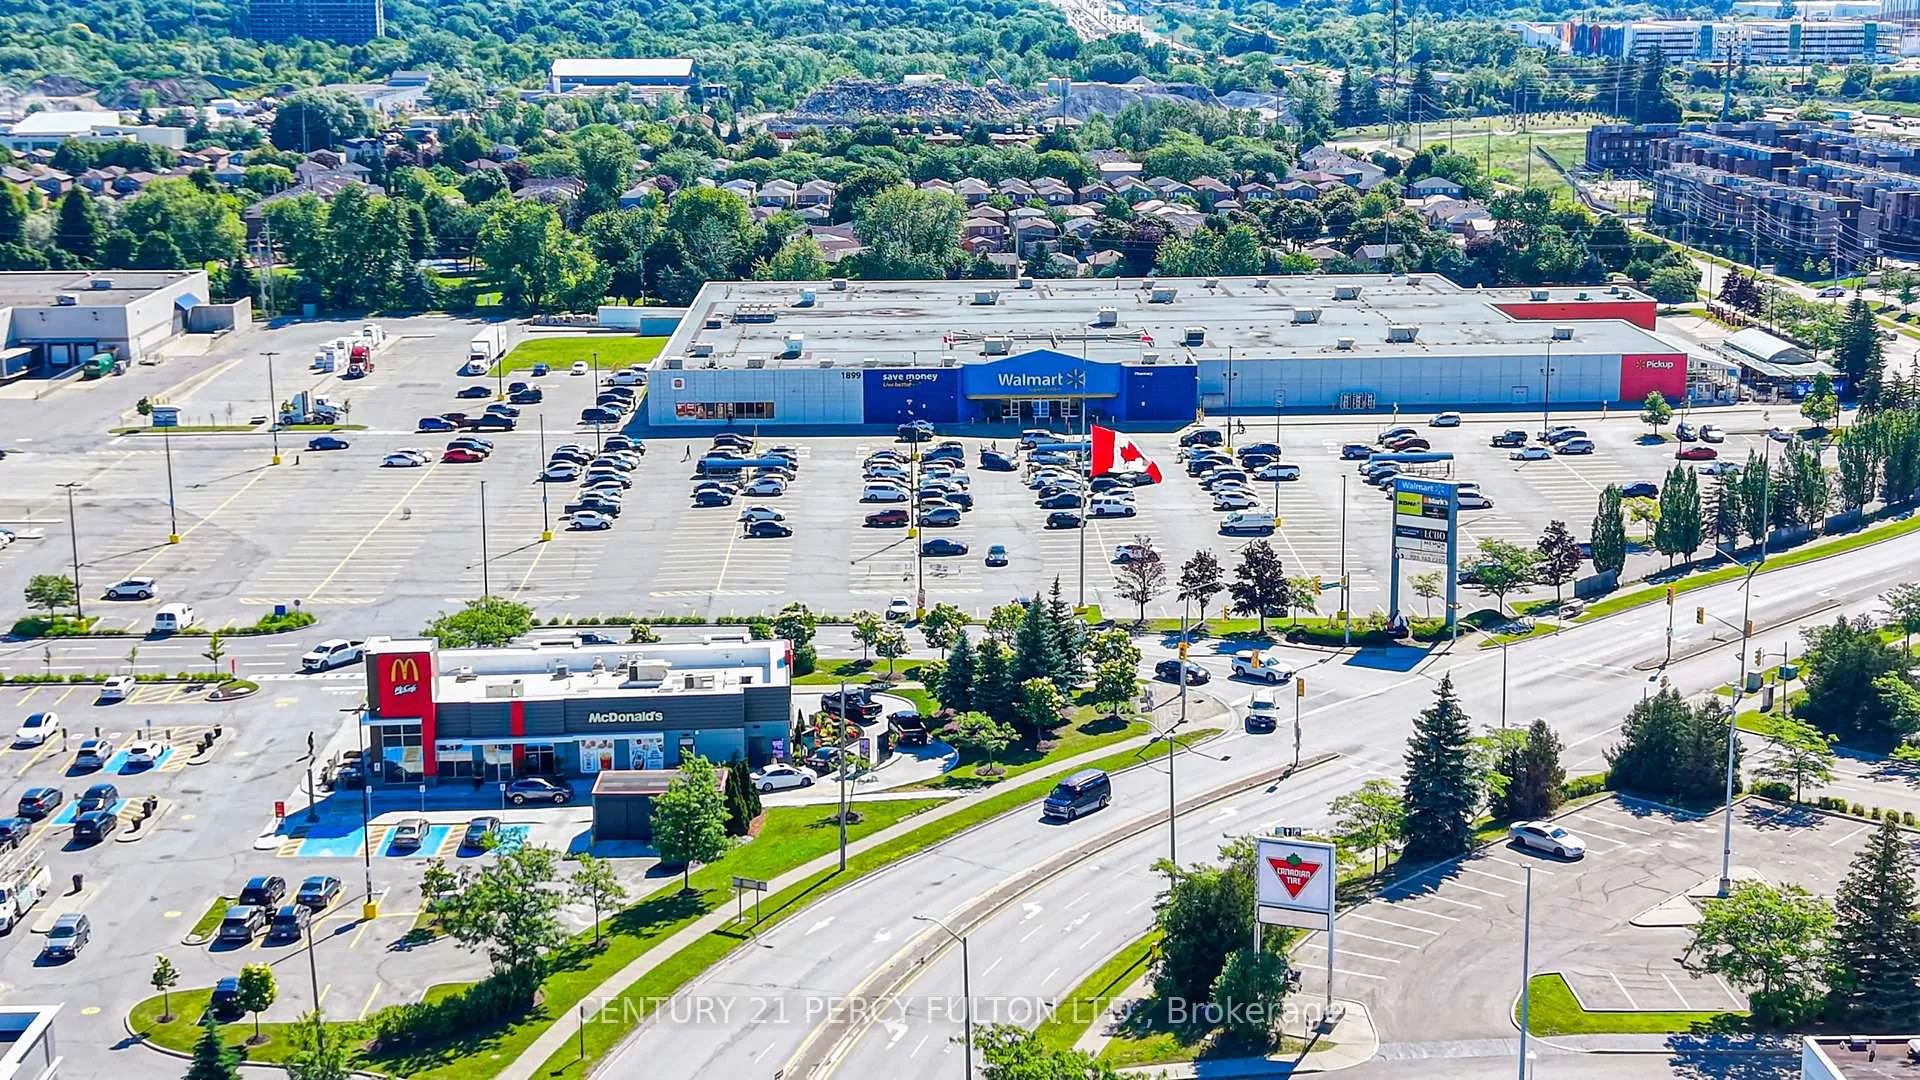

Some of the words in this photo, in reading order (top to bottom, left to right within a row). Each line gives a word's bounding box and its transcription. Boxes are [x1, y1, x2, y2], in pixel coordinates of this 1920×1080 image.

[1646, 360, 1674, 369] Pickup
[882, 373, 904, 381] save
[905, 373, 938, 382] money
[998, 373, 1063, 386] Walmart
[1401, 480, 1434, 492] Walmart
[1424, 529, 1446, 540] LCBO
[588, 711, 664, 723] McDonald's
[1277, 867, 1311, 878] CANADIAN
[1287, 877, 1301, 885] TIRE
